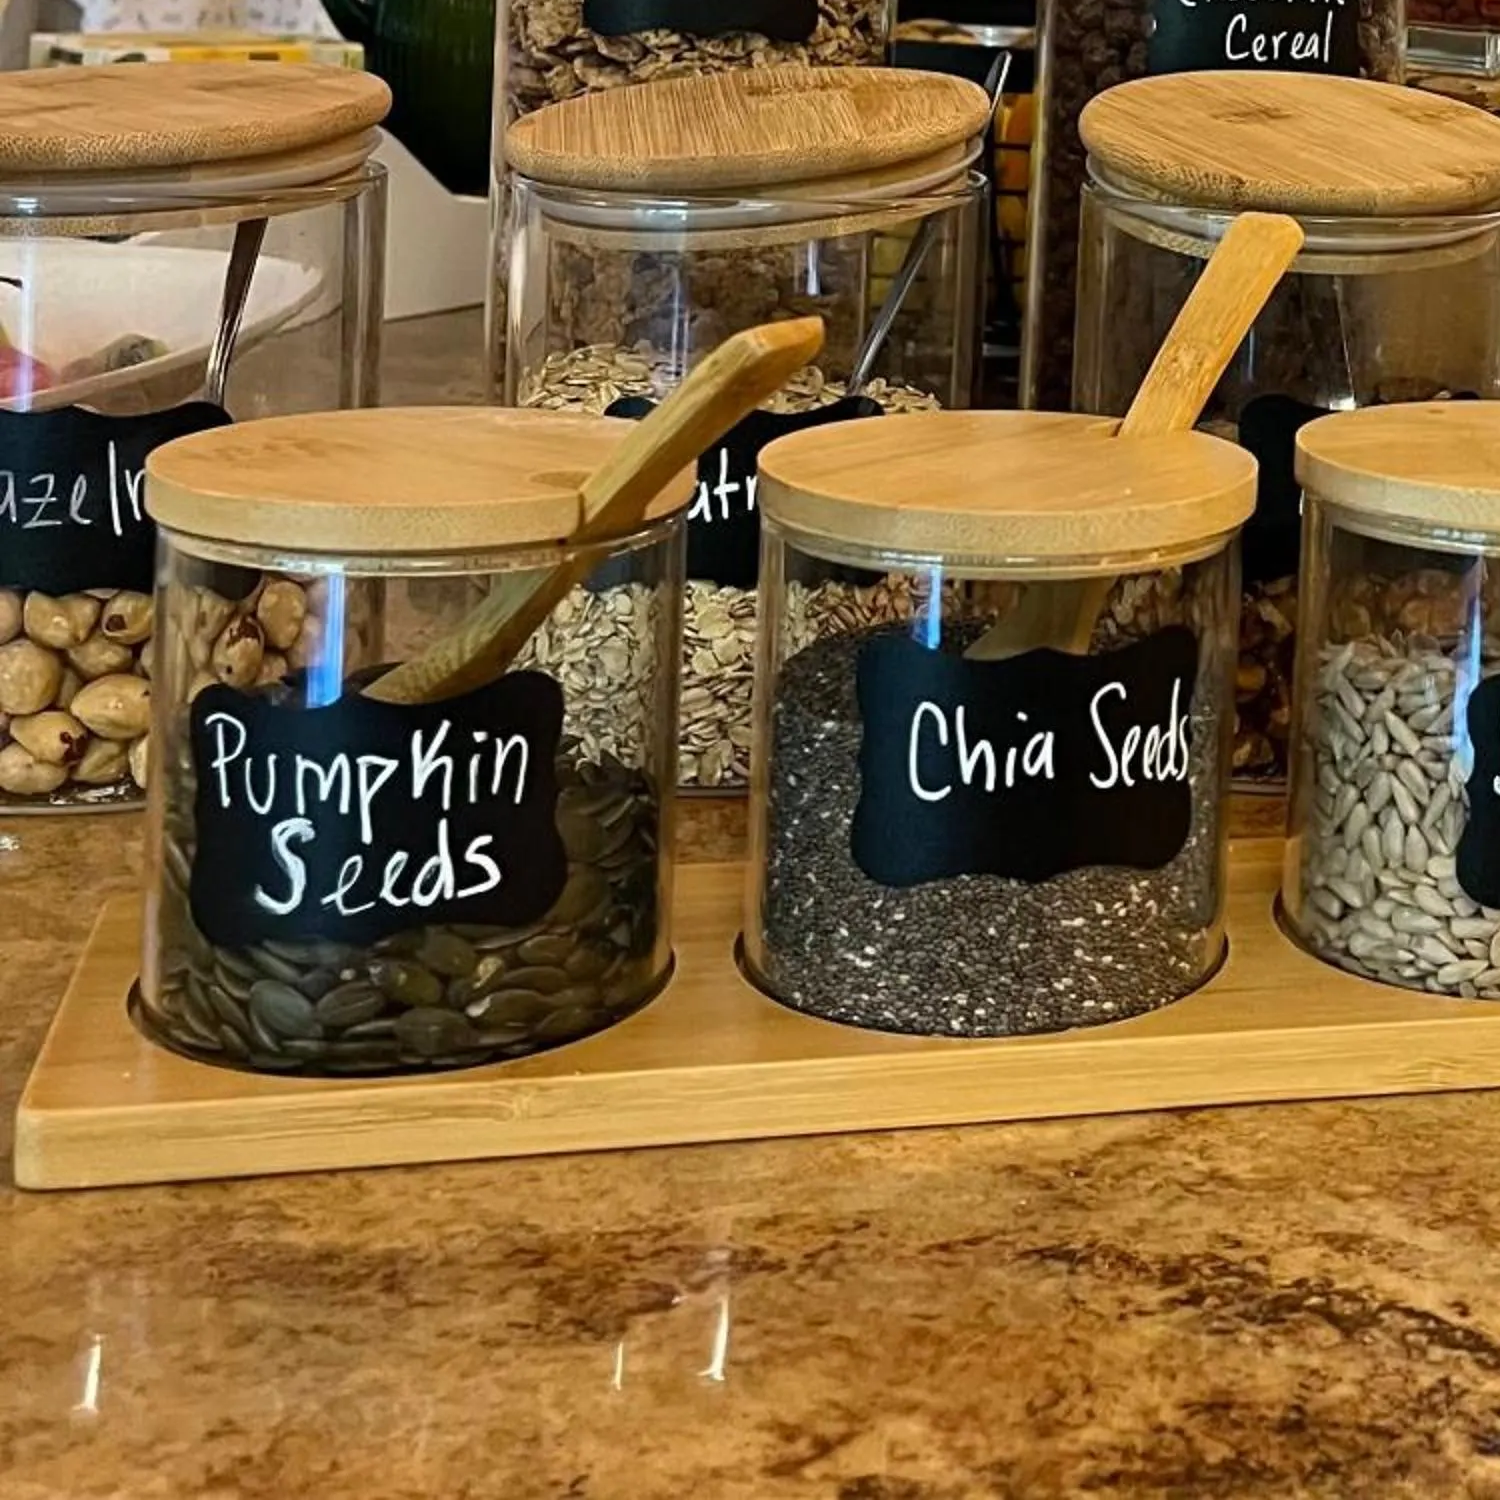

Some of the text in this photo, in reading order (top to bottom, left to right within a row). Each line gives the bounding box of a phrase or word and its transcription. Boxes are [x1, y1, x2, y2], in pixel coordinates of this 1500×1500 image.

[1225, 10, 1333, 63] Cereal
[205, 712, 529, 844] Pumpkin
[909, 677, 1189, 801] Chia Seeds
[255, 818, 501, 915] Seeds
